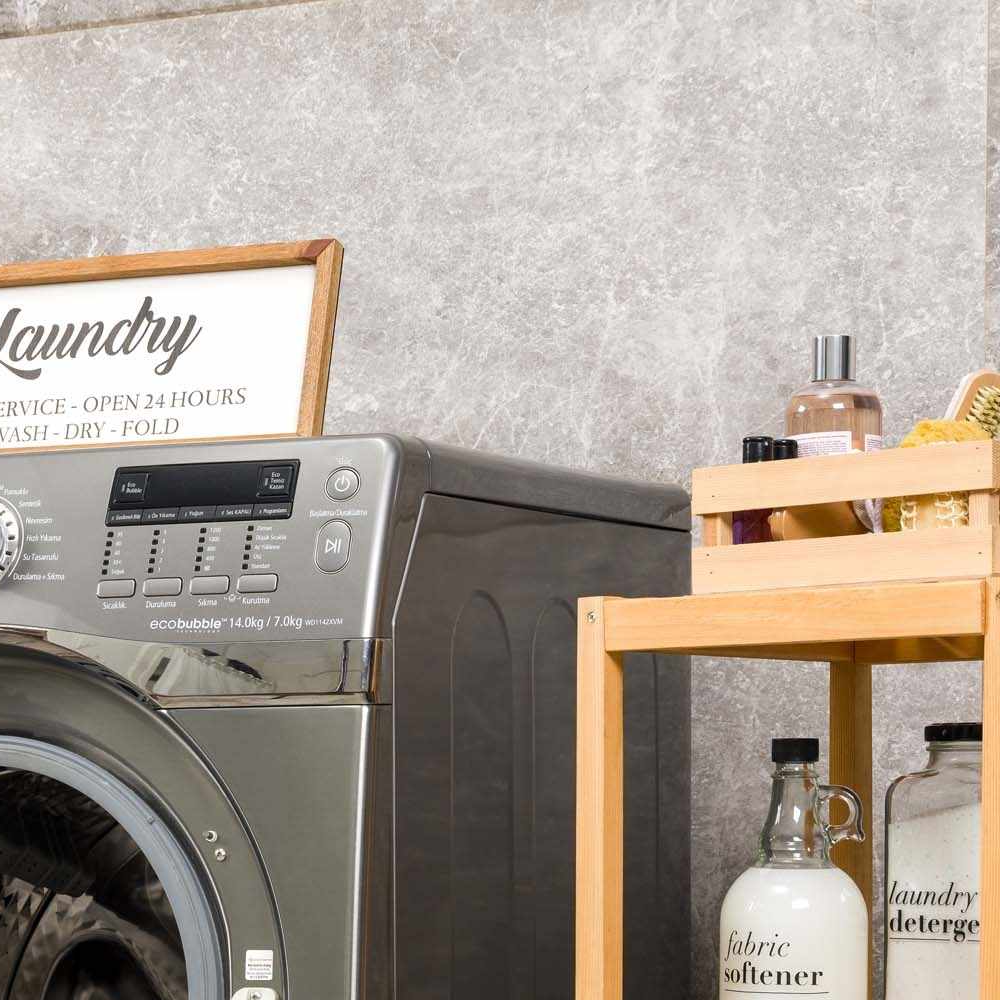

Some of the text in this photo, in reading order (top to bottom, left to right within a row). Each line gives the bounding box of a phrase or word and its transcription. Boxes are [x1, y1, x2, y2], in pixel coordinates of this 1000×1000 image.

[83, 394, 141, 413] OPEN
[144, 393, 166, 410] 24
[171, 387, 247, 408] HOURS
[64, 421, 105, 441] DRY
[122, 417, 180, 437] FOLD
[229, 615, 264, 632] 14.0kg
[274, 615, 303, 630] 7.0kg
[889, 881, 979, 913] laundry
[724, 930, 791, 961] fabric
[724, 961, 824, 986] softener
